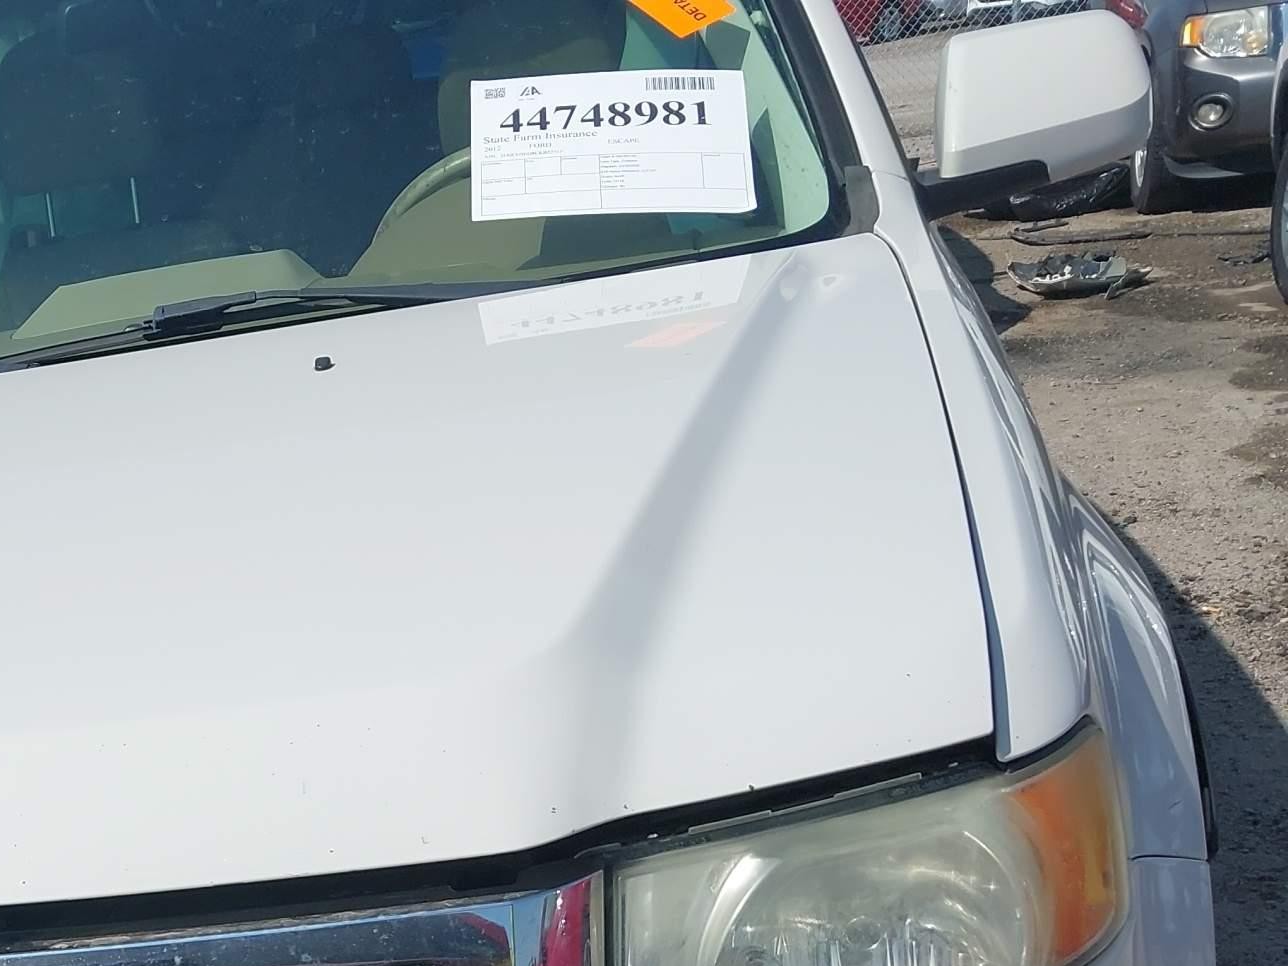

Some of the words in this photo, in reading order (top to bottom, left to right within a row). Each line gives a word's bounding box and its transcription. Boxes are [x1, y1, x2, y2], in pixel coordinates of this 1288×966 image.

[500, 100, 712, 133] 44748981
[483, 136, 510, 145] State
[545, 130, 598, 139] Insurance
